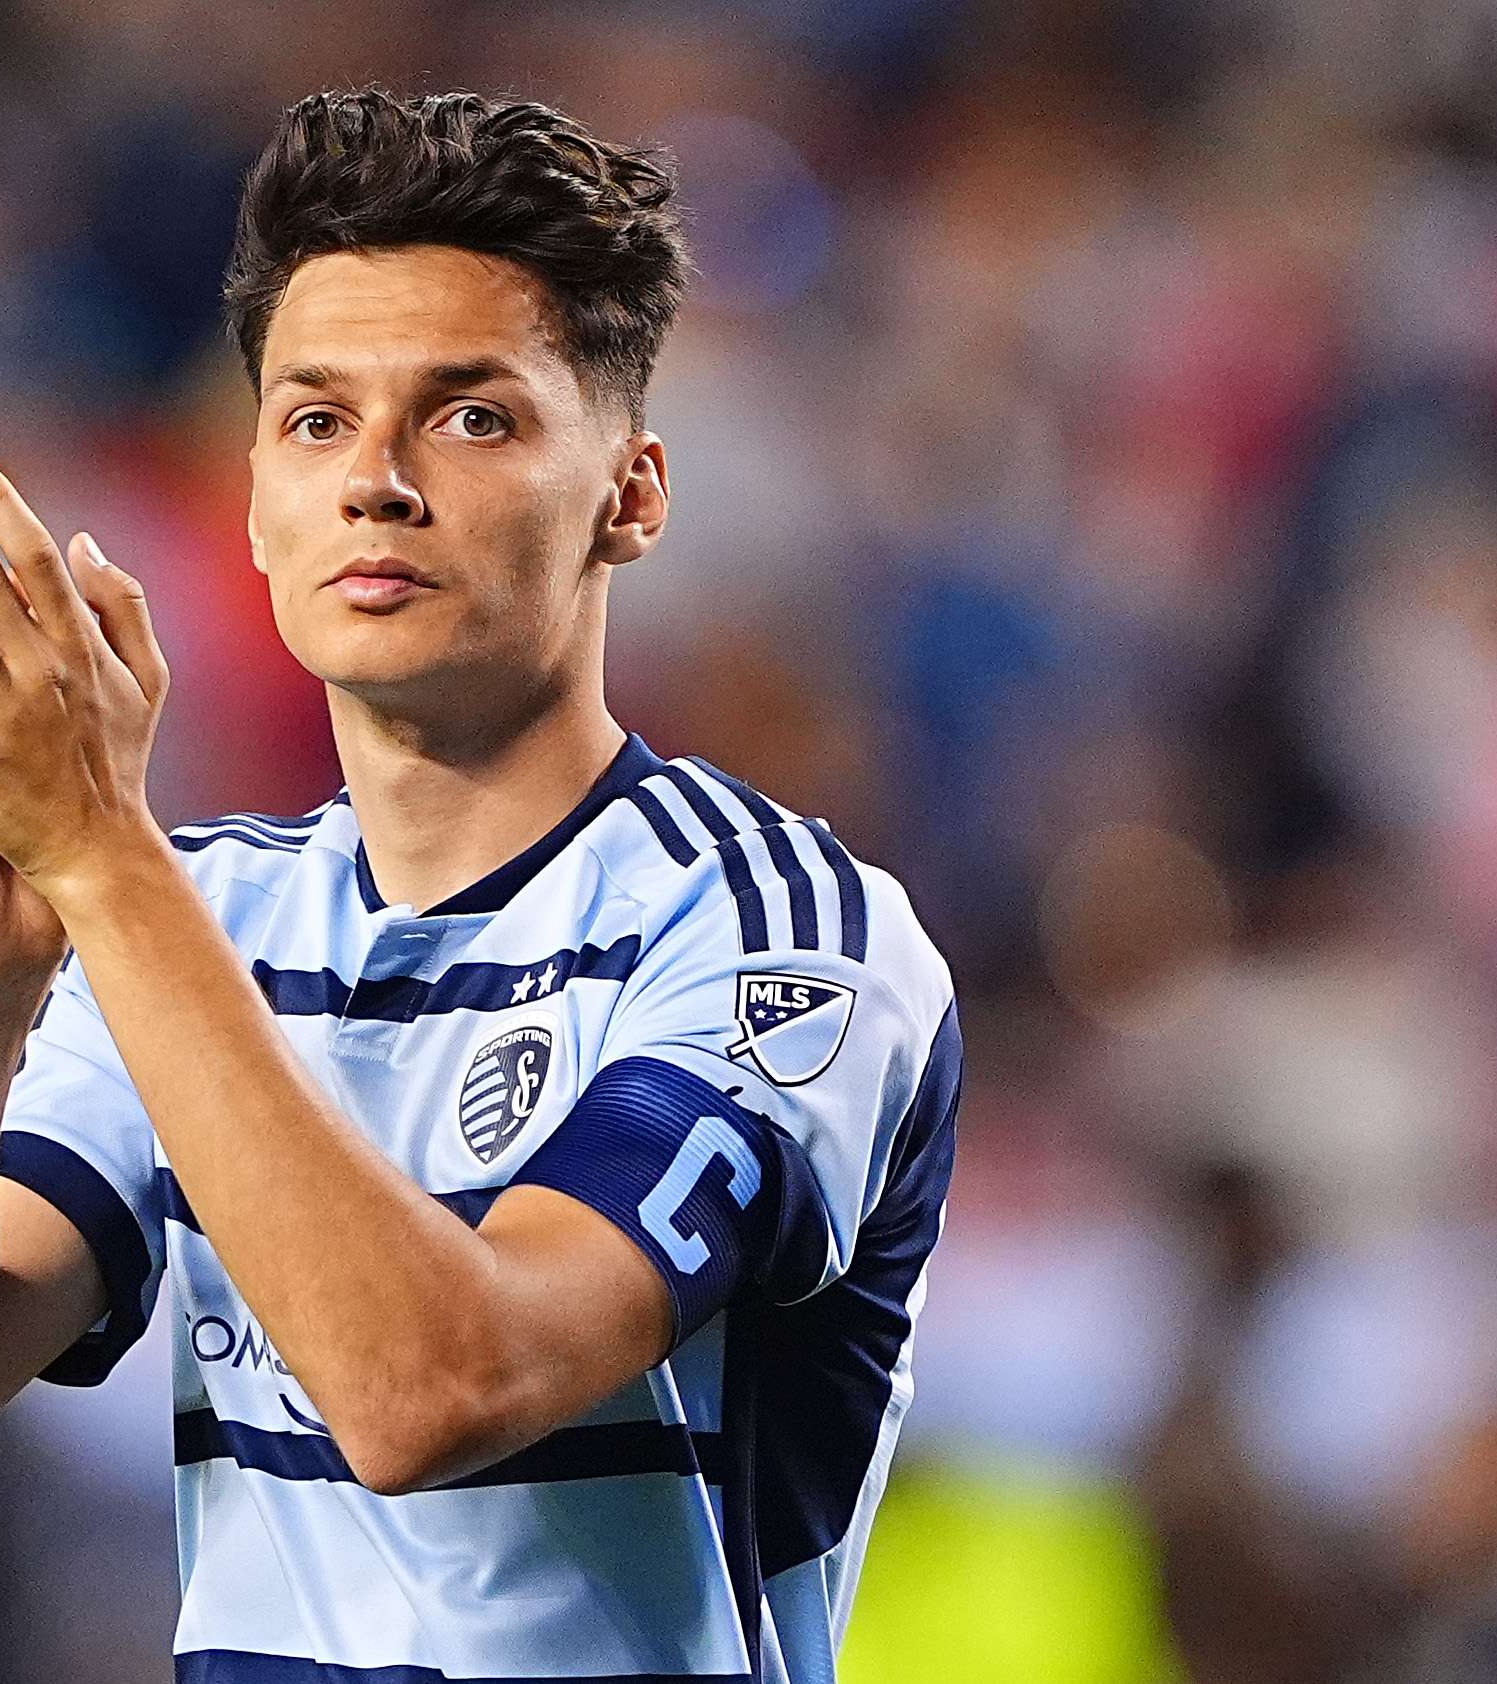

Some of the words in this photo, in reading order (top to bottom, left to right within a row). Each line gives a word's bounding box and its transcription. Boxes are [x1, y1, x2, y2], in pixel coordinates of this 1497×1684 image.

[749, 982, 811, 1010] MLS
[474, 1028, 551, 1063] SPORTING
[637, 1116, 762, 1276] C
